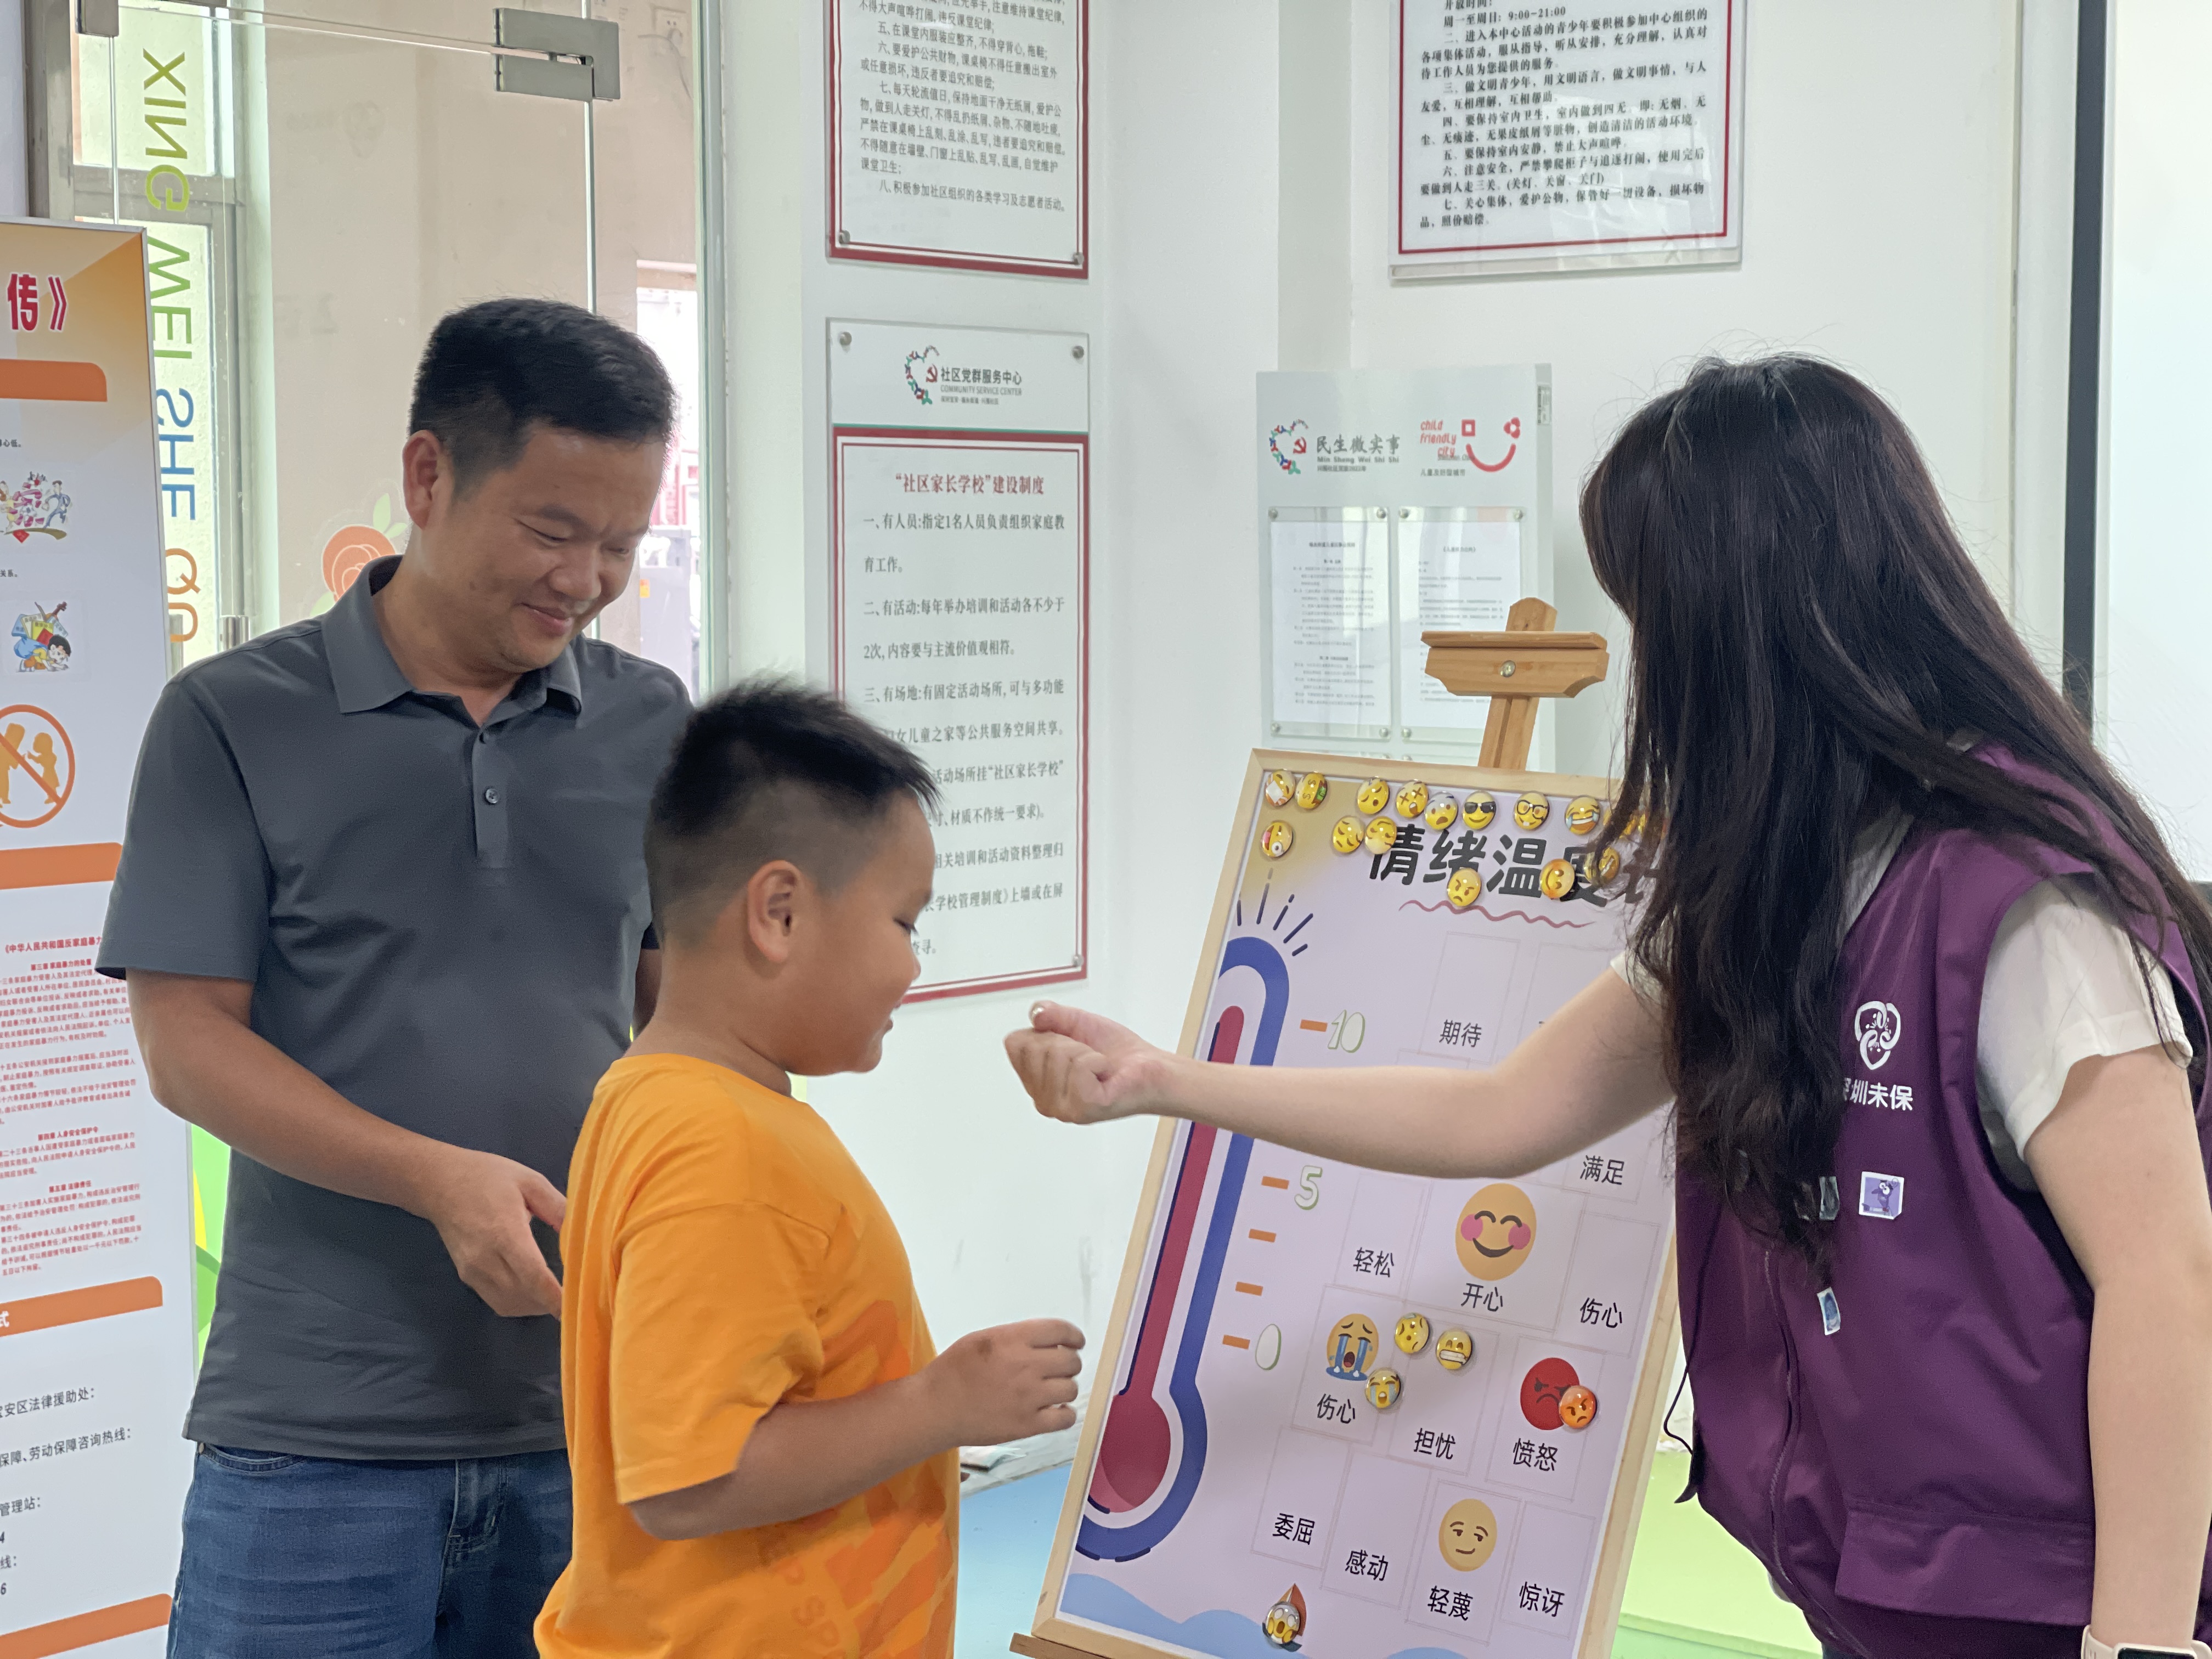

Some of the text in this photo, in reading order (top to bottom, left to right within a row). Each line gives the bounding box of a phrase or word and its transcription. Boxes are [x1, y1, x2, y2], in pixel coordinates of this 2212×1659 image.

[7, 273, 67, 332] 传》
[940, 385, 1022, 396] COMMUNITY SERVICE CENTER
[941, 366, 1022, 385] 社区党群服务中心
[1420, 420, 1443, 431] child
[1317, 433, 1400, 454] 民生微实事
[895, 473, 1044, 495] “社区家长学校”建设制度
[863, 513, 1065, 531] 一、有人员:指定1名人员负责组织家庭教
[865, 556, 903, 573] 育工作。
[1327, 1009, 1366, 1053] 10
[1439, 1019, 1482, 1048] 期待
[1579, 1155, 1626, 1186] 满足
[1294, 1165, 1323, 1210] 5
[1353, 1246, 1395, 1278] 轻松
[1462, 1282, 1504, 1313] 开心
[1579, 1297, 1623, 1329] 伤心
[0, 1386, 94, 1418] 安区法律援助处:
[1317, 1393, 1356, 1425] 伤心
[1414, 1427, 1456, 1460] 担忧
[1513, 1437, 1559, 1472] 愤怒
[1272, 1513, 1316, 1545] 委屈
[1345, 1549, 1389, 1582] 感动
[1427, 1584, 1474, 1621] 轻蔑
[1519, 1581, 1565, 1618] 惊讶
